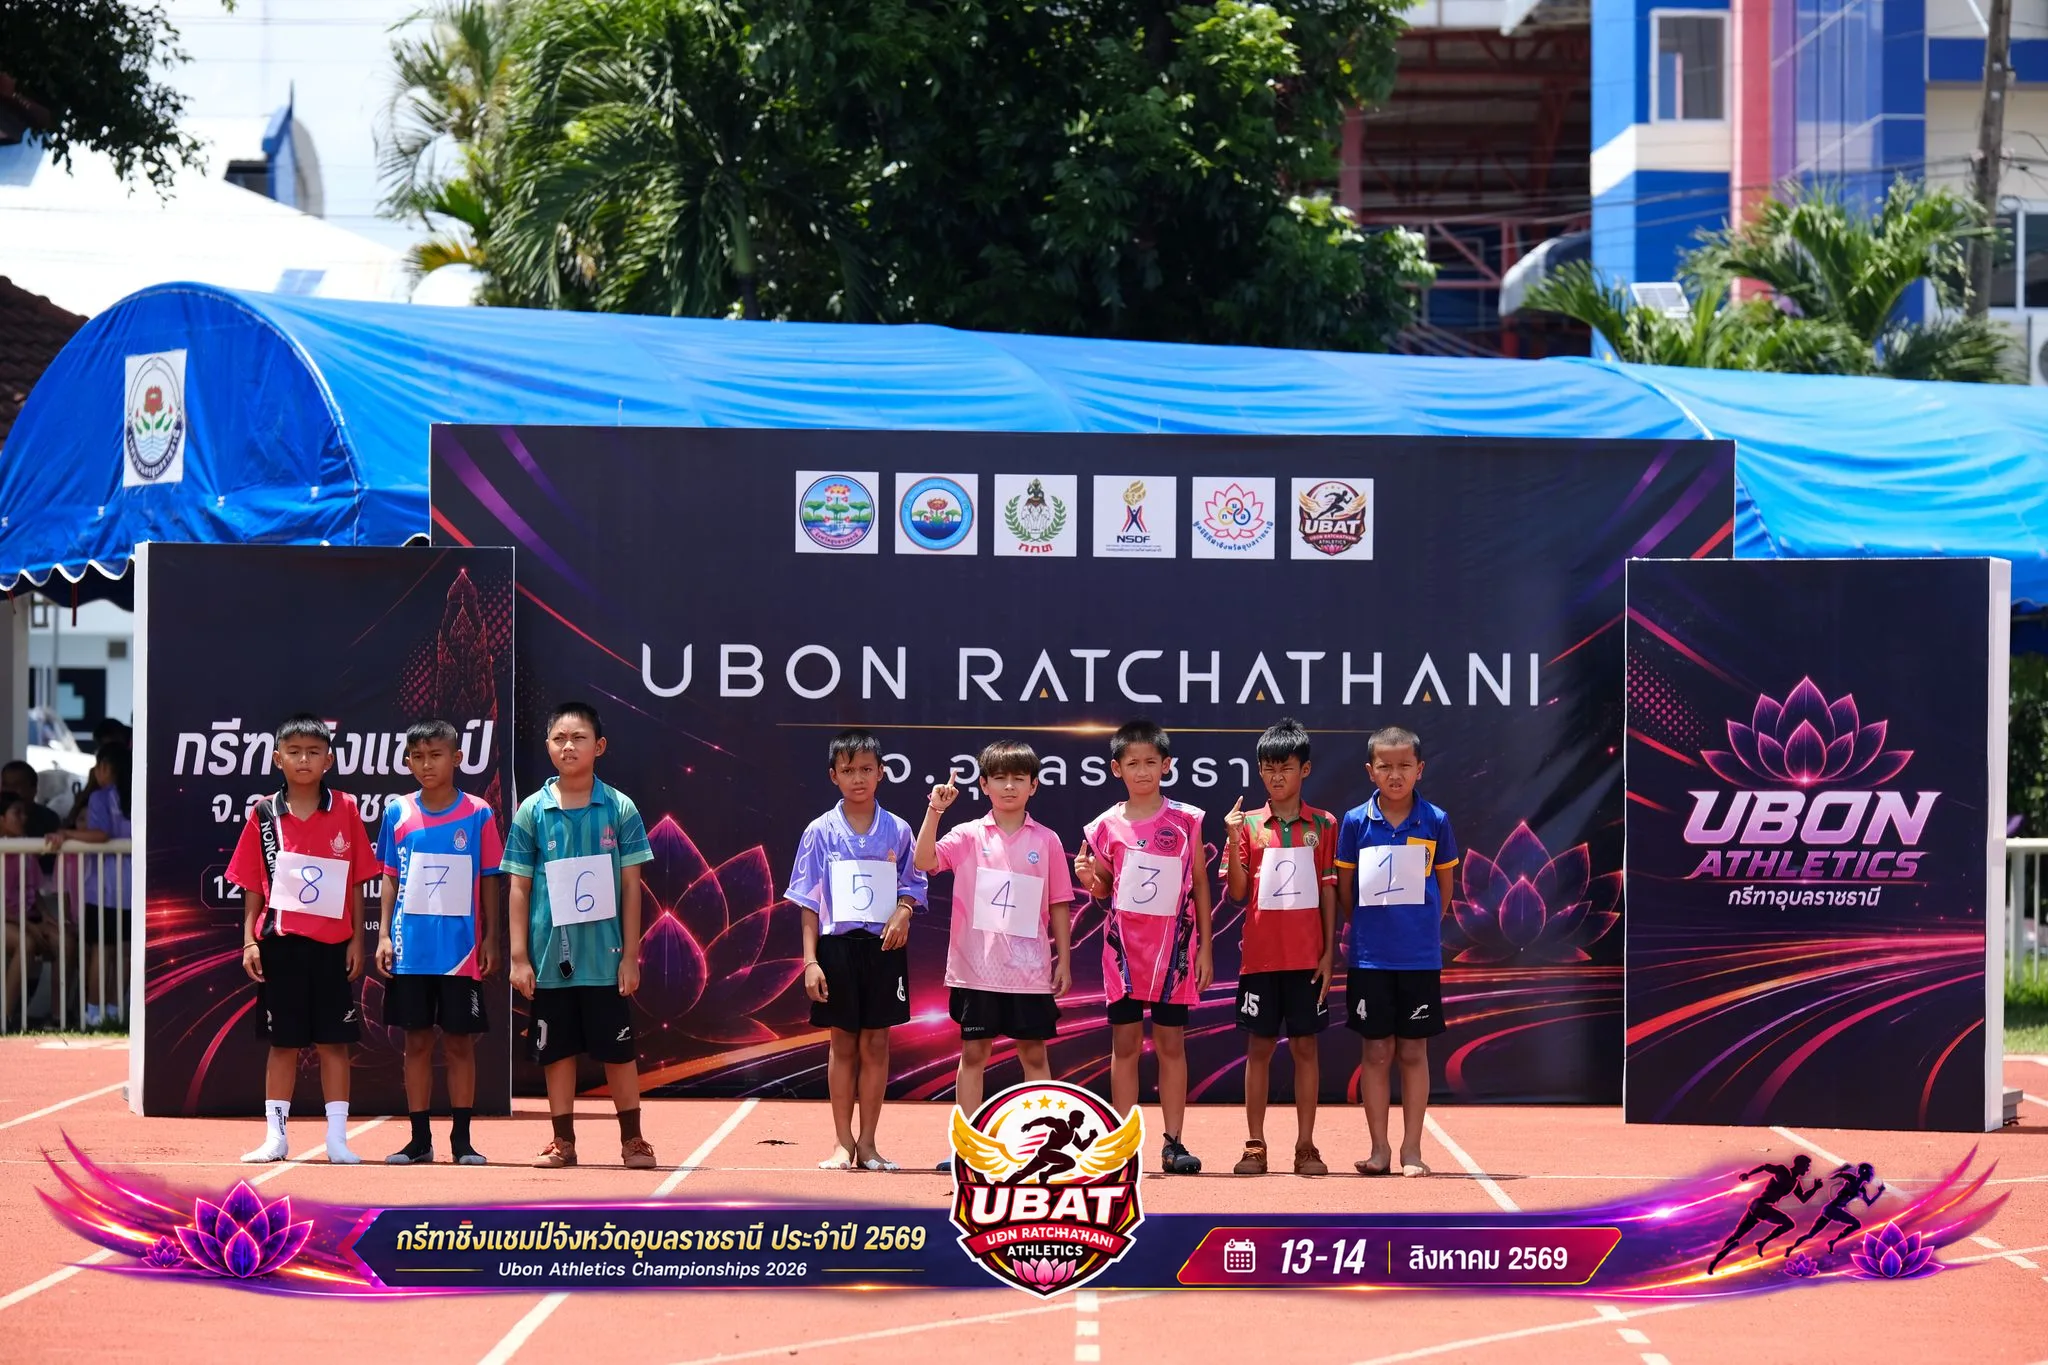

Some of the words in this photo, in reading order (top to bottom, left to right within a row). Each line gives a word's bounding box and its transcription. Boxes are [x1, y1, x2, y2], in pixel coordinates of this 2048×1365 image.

[1116, 535, 1151, 543] NSDF
[1304, 519, 1361, 535] UBAT
[640, 643, 906, 700] UBON
[959, 646, 1539, 706] RATCHATHANI
[1683, 790, 1942, 845] UBON
[423, 866, 450, 898] 7
[1272, 860, 1301, 897] 2
[1374, 853, 1404, 896] 1
[1682, 849, 1931, 880] ATHLETICS
[299, 865, 323, 904] 8
[574, 871, 595, 912] 6
[852, 874, 874, 911] 5
[991, 880, 1016, 919] 4
[1132, 865, 1160, 904] 3
[1728, 885, 1881, 911] กรีฑาอุบลราชธานี
[1241, 990, 1260, 1018] 15
[1356, 998, 1368, 1020] 4
